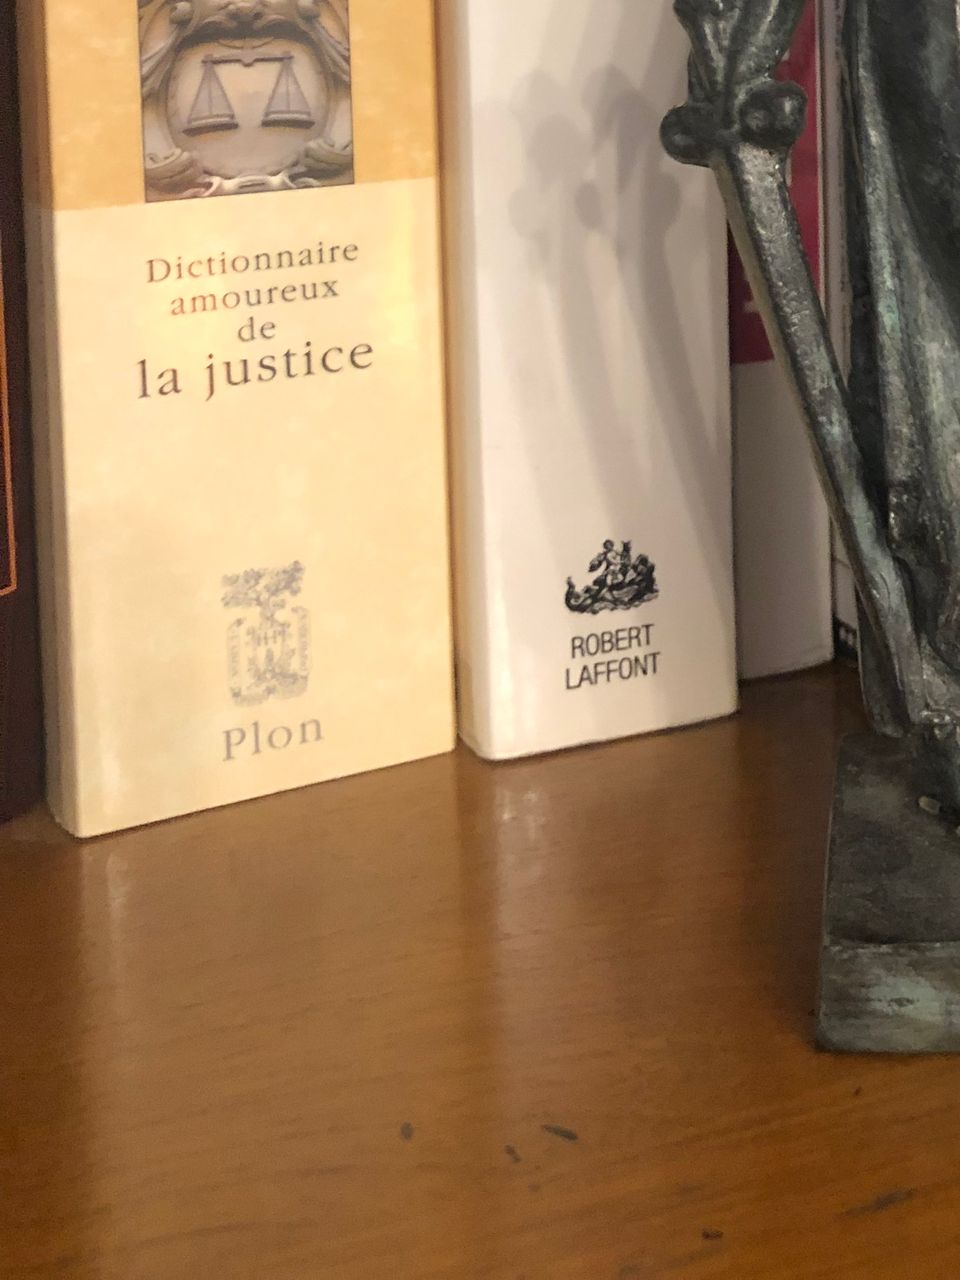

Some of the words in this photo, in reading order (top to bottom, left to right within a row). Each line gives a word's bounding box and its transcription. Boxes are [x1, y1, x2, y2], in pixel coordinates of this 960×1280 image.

[146, 240, 360, 283] Dictionnaire
[170, 277, 340, 316] amoureux
[237, 317, 276, 342] de
[138, 359, 182, 399] la
[204, 340, 374, 402] justice
[571, 624, 655, 658] ROBERT
[565, 652, 661, 689] LAFFONT
[222, 718, 324, 761] Plon
